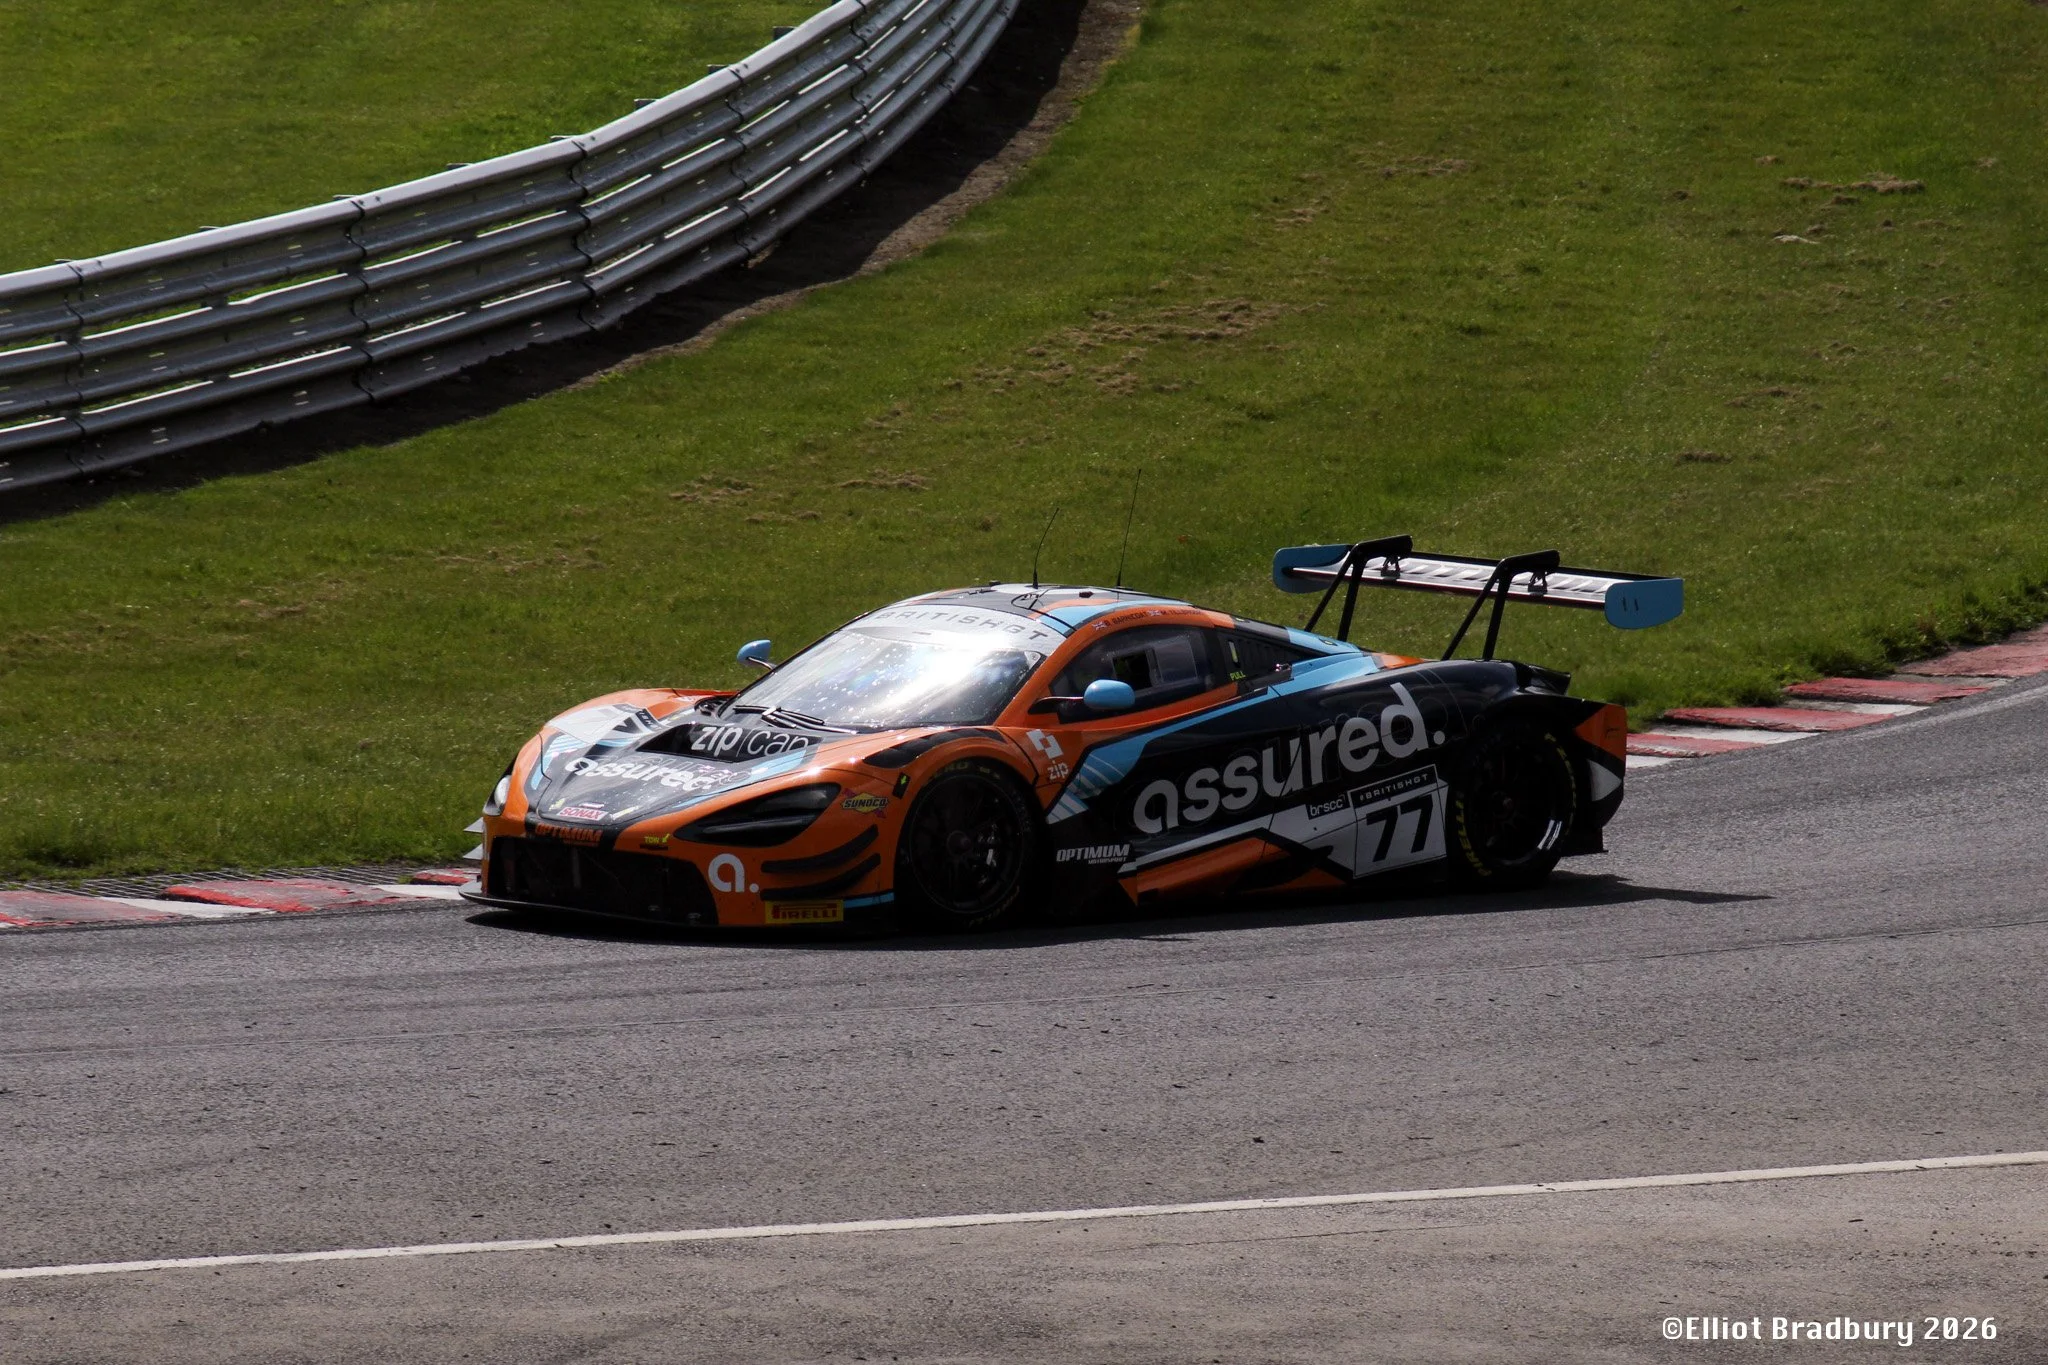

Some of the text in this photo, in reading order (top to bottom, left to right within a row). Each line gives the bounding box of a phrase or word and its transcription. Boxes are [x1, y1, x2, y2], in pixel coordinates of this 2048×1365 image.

[1229, 671, 1246, 681] PULL
[1132, 681, 1446, 834] assured.
[1047, 760, 1069, 780] zip
[843, 797, 888, 808] SUNOCO
[1309, 798, 1344, 817] brscc
[559, 807, 603, 819] SONAX
[1366, 793, 1434, 863] 77
[1056, 844, 1130, 862] OPTIMUM
[771, 903, 837, 919] PIRELLI
